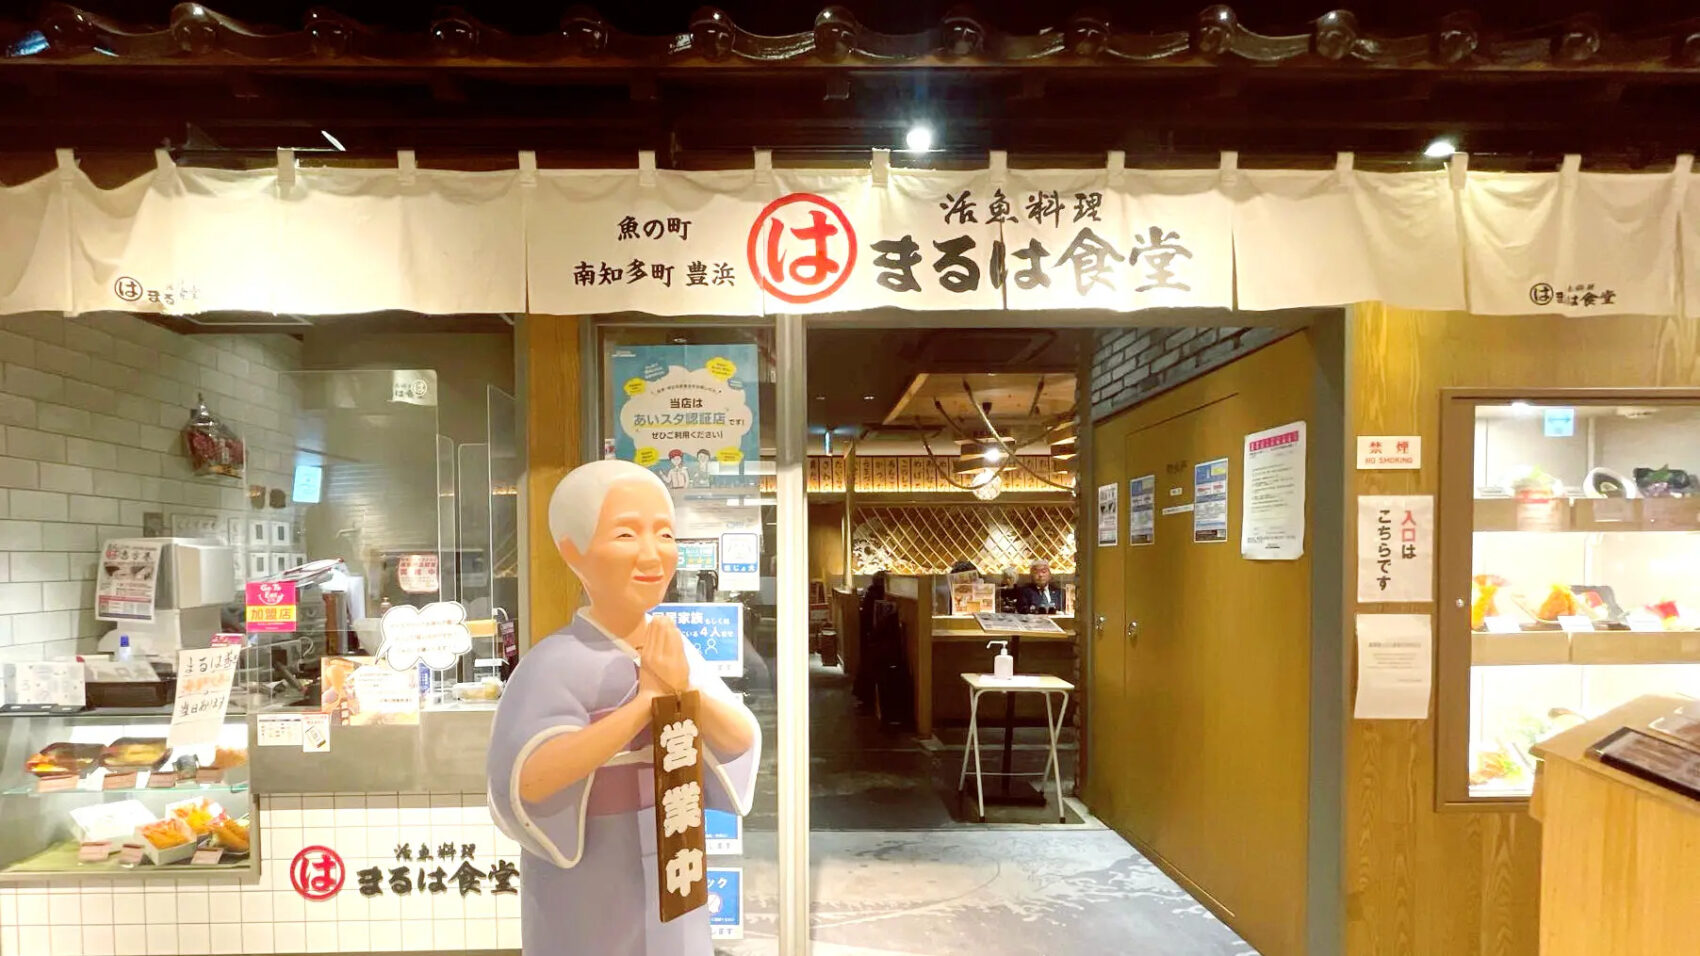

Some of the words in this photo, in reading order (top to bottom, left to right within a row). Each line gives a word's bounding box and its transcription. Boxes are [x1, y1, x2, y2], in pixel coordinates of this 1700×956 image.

[939, 189, 1104, 227] 活魚料理
[617, 215, 692, 241] 魚の町
[573, 258, 675, 288] 南知多町
[685, 260, 736, 287] 豊浜
[869, 226, 1193, 297] まるは食堂
[670, 398, 703, 409] 当店は
[1369, 440, 1410, 455] 禁煙
[1376, 509, 1392, 591] こちらです
[1401, 509, 1417, 560] 入口は
[260, 584, 272, 592] Go
[272, 584, 282, 592] To
[251, 608, 291, 620] 加盟店
[659, 718, 704, 898] 営業中
[356, 859, 520, 898] まるは食堂
